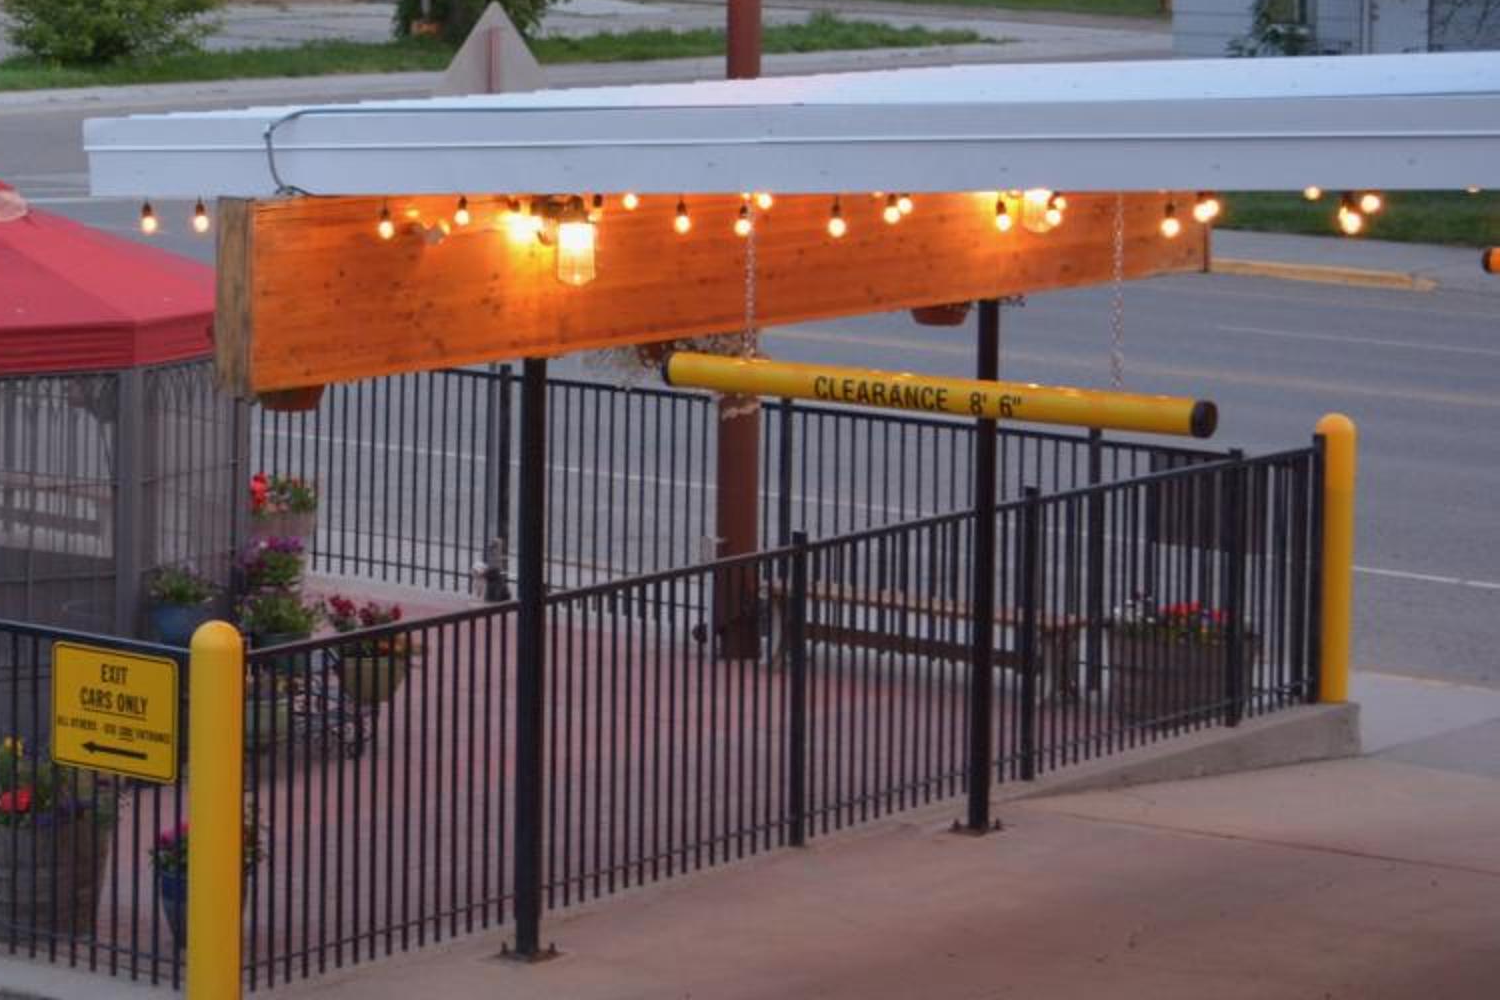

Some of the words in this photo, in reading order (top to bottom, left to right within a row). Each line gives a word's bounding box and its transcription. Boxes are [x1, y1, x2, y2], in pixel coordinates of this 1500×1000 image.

[814, 375, 949, 411] CLEARANCE
[969, 391, 987, 416] 8'
[101, 663, 128, 685] EXIT
[80, 685, 113, 710] CARS
[117, 692, 148, 715] ONLY
